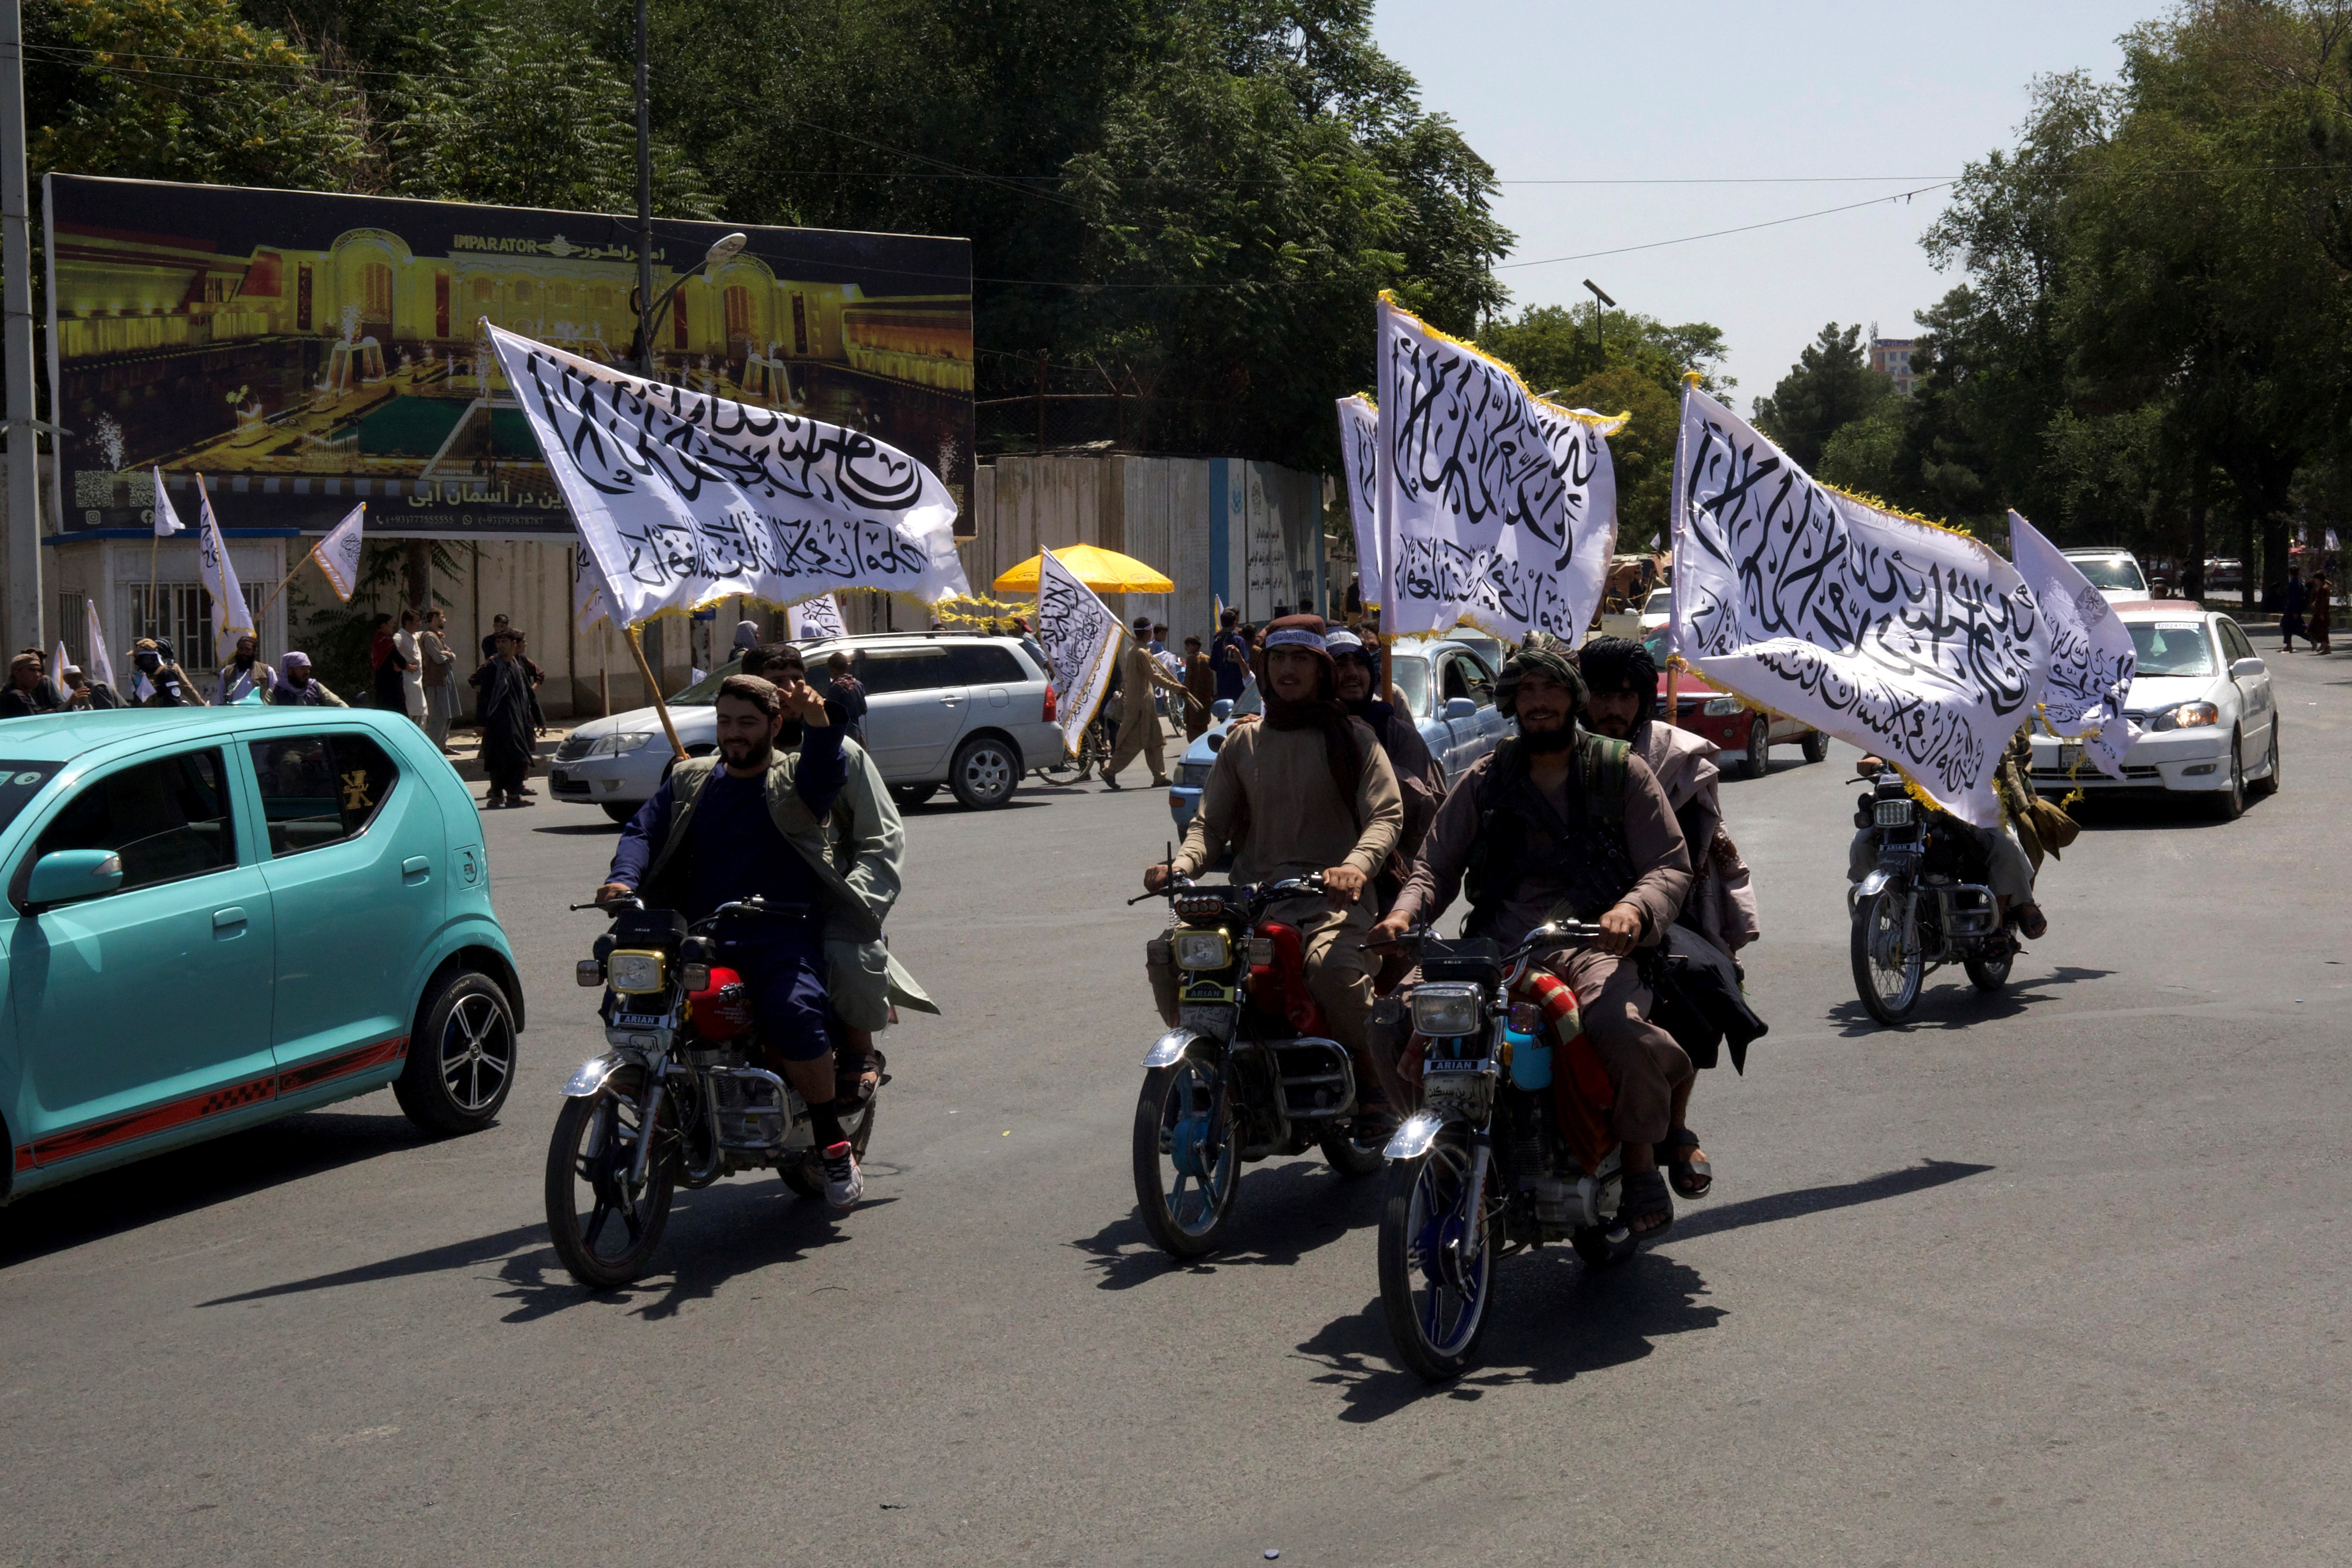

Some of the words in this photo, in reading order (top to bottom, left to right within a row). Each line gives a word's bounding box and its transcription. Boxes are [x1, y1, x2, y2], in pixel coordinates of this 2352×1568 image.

[454, 234, 537, 254] IMPARATOR
[579, 243, 665, 261] امراطور
[408, 481, 441, 508] آبی
[446, 480, 511, 506] آسمان
[516, 493, 533, 509] در
[1436, 1061, 1472, 1070] ARIAN
